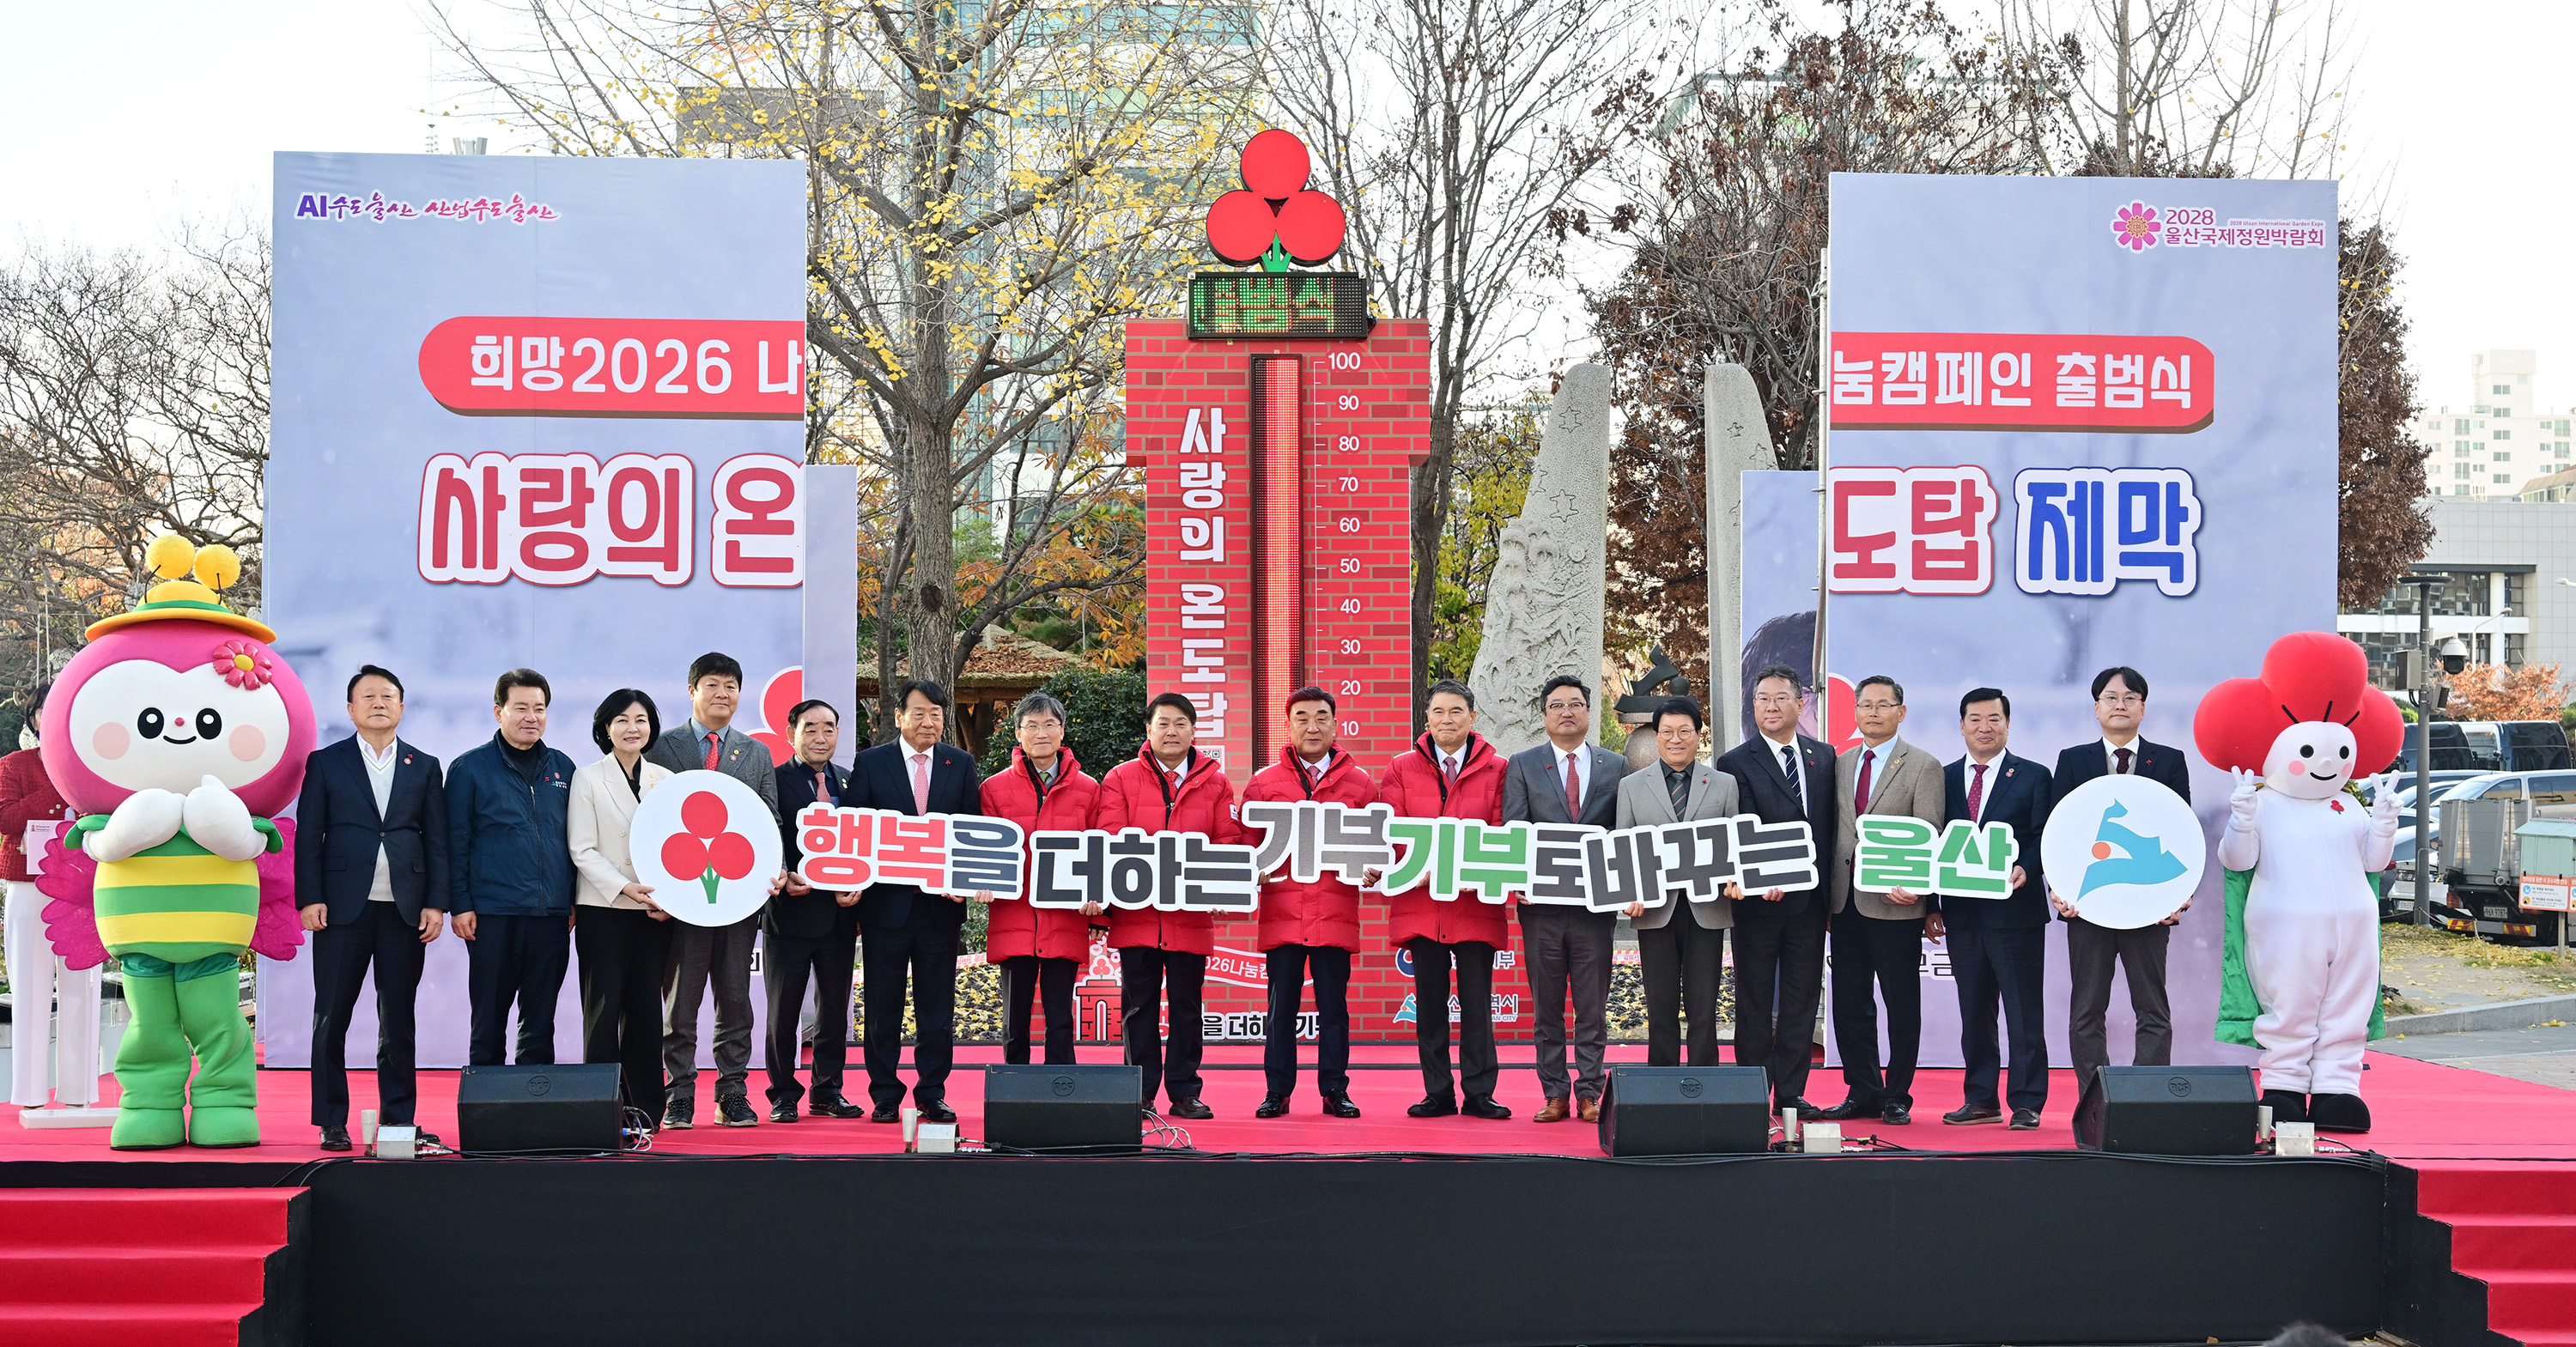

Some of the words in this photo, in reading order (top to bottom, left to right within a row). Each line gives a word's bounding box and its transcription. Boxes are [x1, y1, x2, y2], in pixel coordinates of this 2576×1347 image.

[2166, 209, 2214, 226] 2028
[2165, 227, 2324, 246] 울산국제정원박람회
[470, 334, 732, 394] 희망2026
[759, 340, 802, 395] 나
[1328, 353, 1361, 371] 100
[1833, 349, 2032, 407] 눔캠페인
[2056, 351, 2191, 409] 출범식
[1339, 395, 1359, 410] 90
[1339, 436, 1359, 452] 80
[1179, 408, 1226, 561] 사랑의
[1339, 477, 1358, 492] 70
[431, 464, 680, 573] 사랑의
[725, 466, 795, 573] 온
[1340, 518, 1360, 533] 60
[1832, 477, 1984, 581] 도탑
[2026, 478, 2190, 585] 제막
[1340, 558, 1360, 573] 50
[1340, 598, 1361, 614] 40
[1340, 639, 1361, 654] 30
[1181, 584, 1228, 737] 온도탑
[1340, 680, 1361, 695] 20
[1341, 720, 1359, 736] 10
[804, 809, 1018, 894] 행복을
[1036, 833, 1253, 905] 더하는
[1248, 807, 1389, 878] 기부
[1586, 820, 1812, 906] 바꾸는
[1861, 820, 2012, 893] 울산
[1682, 1083, 1700, 1093] RCF
